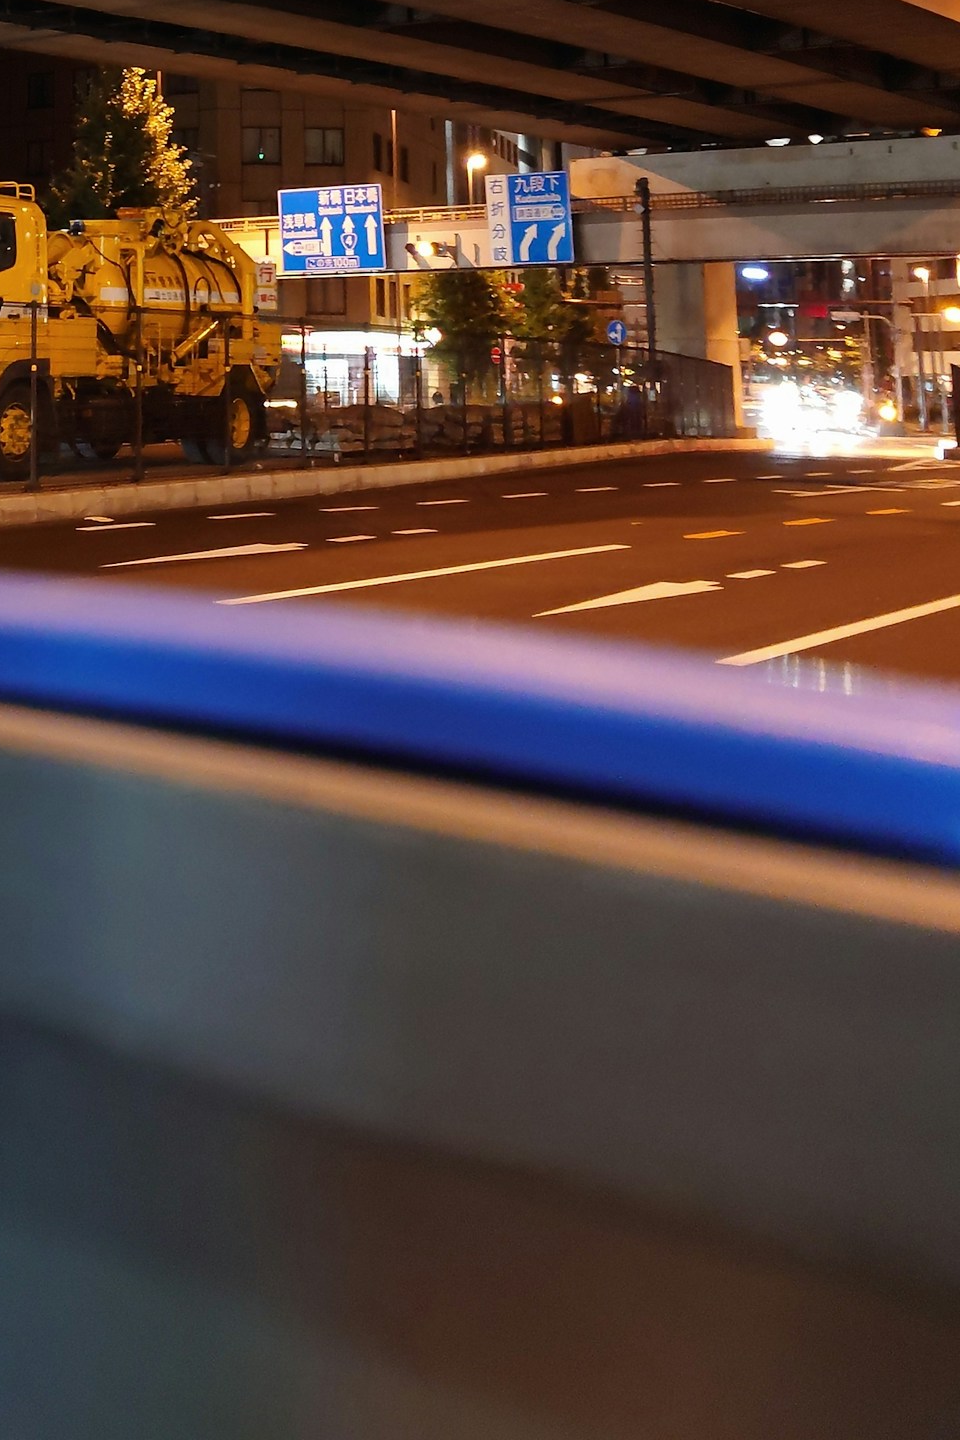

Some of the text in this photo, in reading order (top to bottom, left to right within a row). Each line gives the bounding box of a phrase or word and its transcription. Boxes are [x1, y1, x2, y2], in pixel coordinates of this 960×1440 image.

[514, 175, 560, 192] 九段下
[489, 179, 508, 261] 右折分岐
